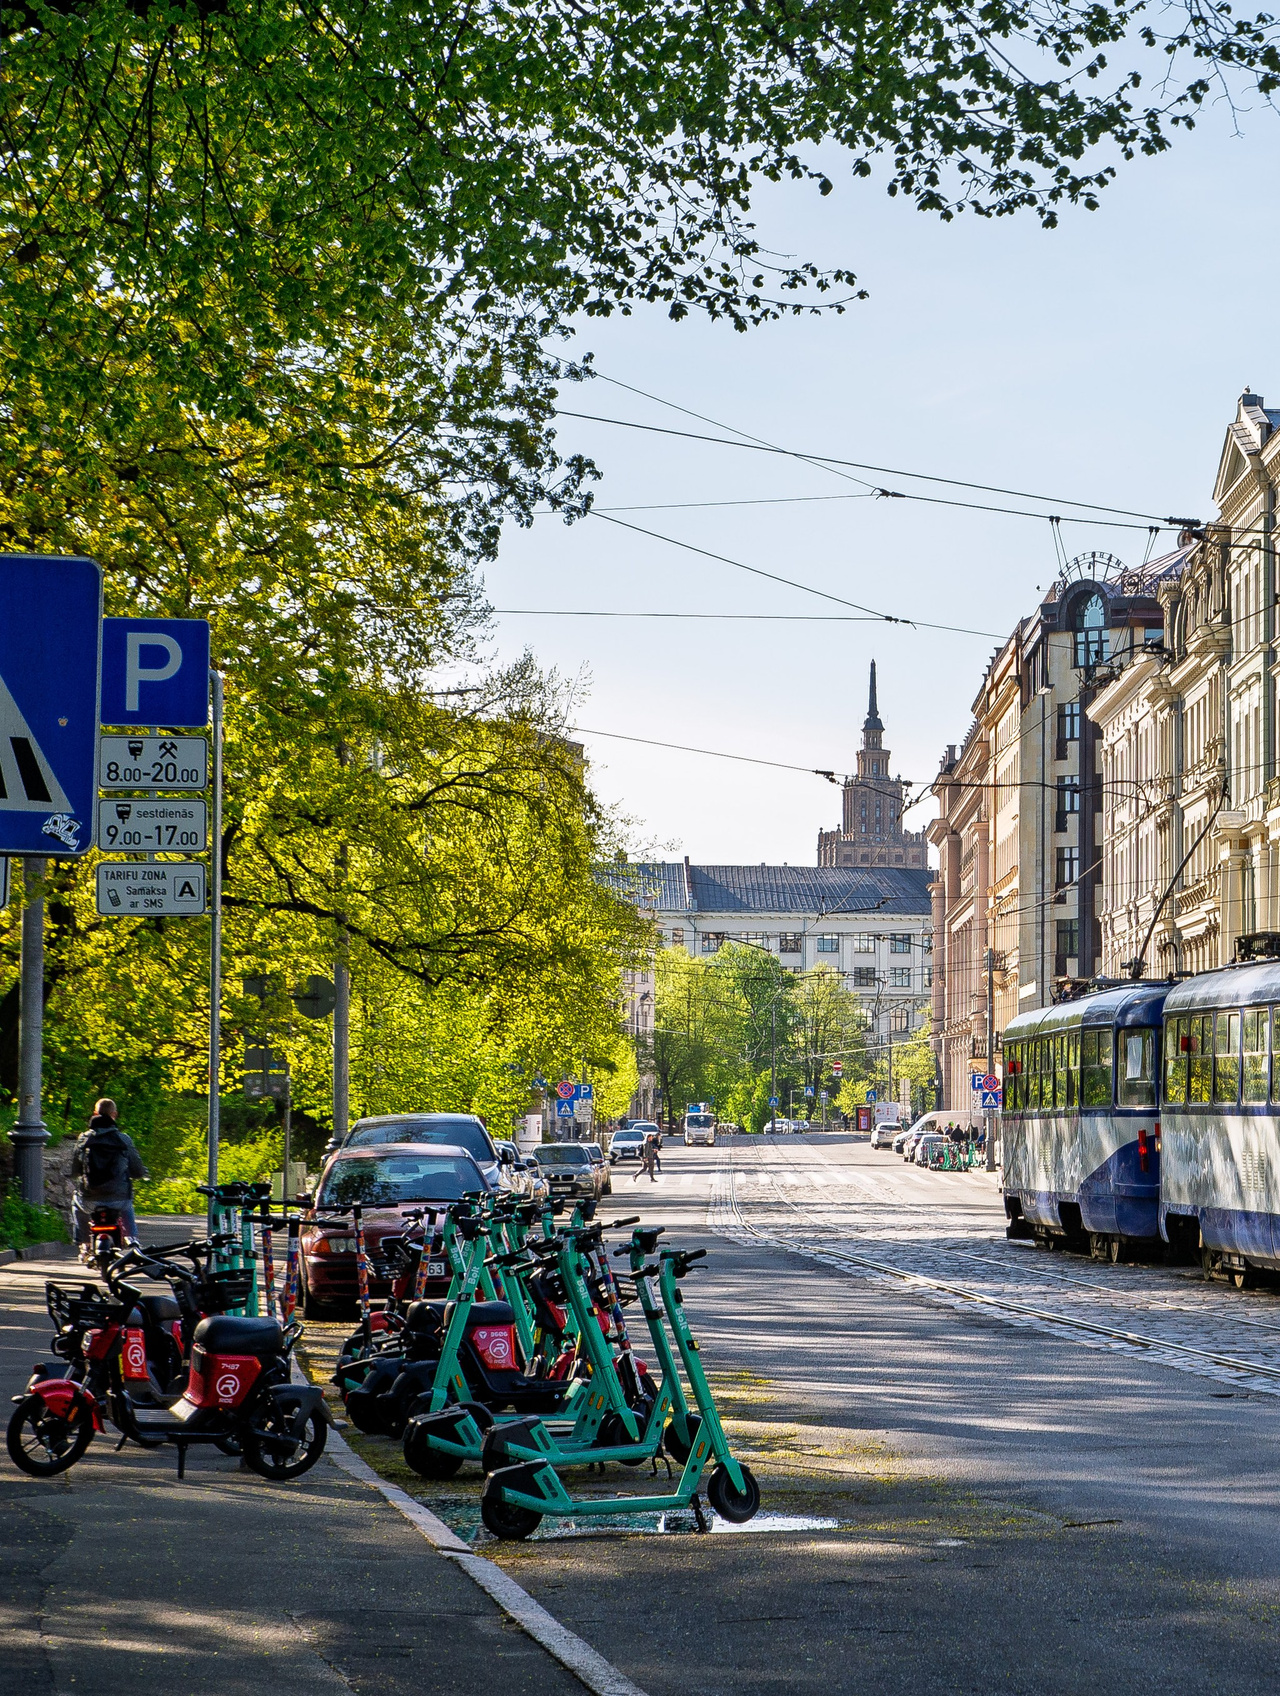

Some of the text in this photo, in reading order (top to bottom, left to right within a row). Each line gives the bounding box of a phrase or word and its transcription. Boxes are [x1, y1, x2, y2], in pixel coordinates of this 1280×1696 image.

[125, 632, 183, 712] P
[106, 761, 199, 783] 8.00-20.00
[136, 808, 194, 819] sestdienās
[104, 870, 167, 880] TARIFU ZONA
[126, 886, 167, 896] Samaksa
[178, 880, 196, 898] A
[129, 898, 163, 909] ar SMS
[975, 1076, 983, 1088] P
[581, 1085, 590, 1097] P
[450, 1247, 461, 1264] Bolt
[428, 1264, 443, 1275] 63
[467, 1266, 480, 1285] Bolt
[577, 1279, 588, 1300] Bolt
[637, 1281, 647, 1301] Bolt
[675, 1307, 688, 1331] Bolt
